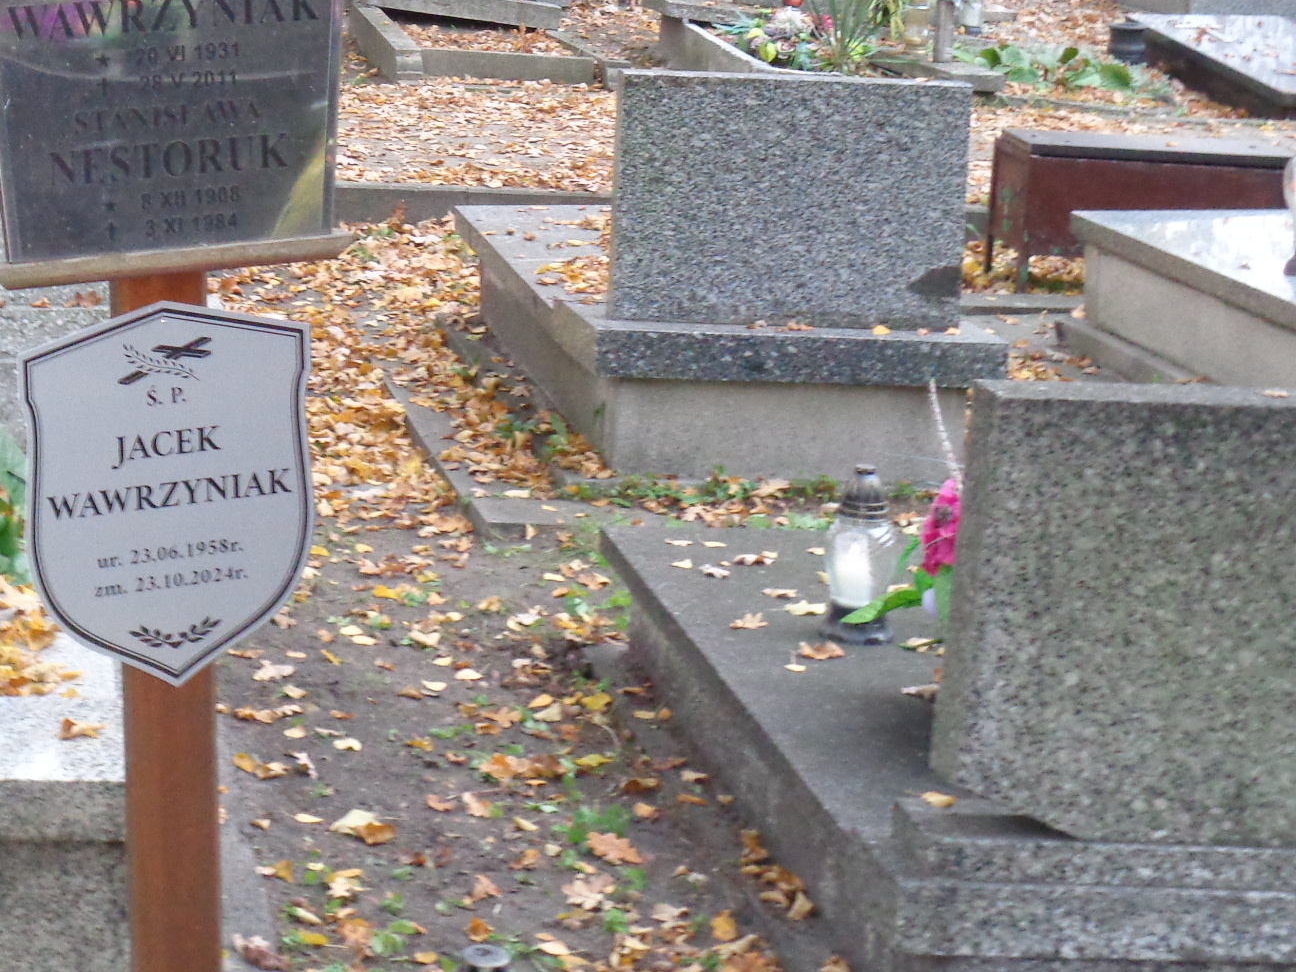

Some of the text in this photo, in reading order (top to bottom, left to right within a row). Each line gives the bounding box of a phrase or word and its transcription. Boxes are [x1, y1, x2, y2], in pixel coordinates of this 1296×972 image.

[193, 41, 241, 61] 1931
[193, 68, 237, 87] 2011
[49, 132, 289, 185] NESTORUK
[170, 386, 187, 404] P.
[111, 425, 222, 470] JACEK
[46, 468, 293, 521] WAWRZYNIAK
[97, 538, 245, 569] ur. 23.06.1958r.
[94, 566, 249, 597] zm. 23.10.2024r.
